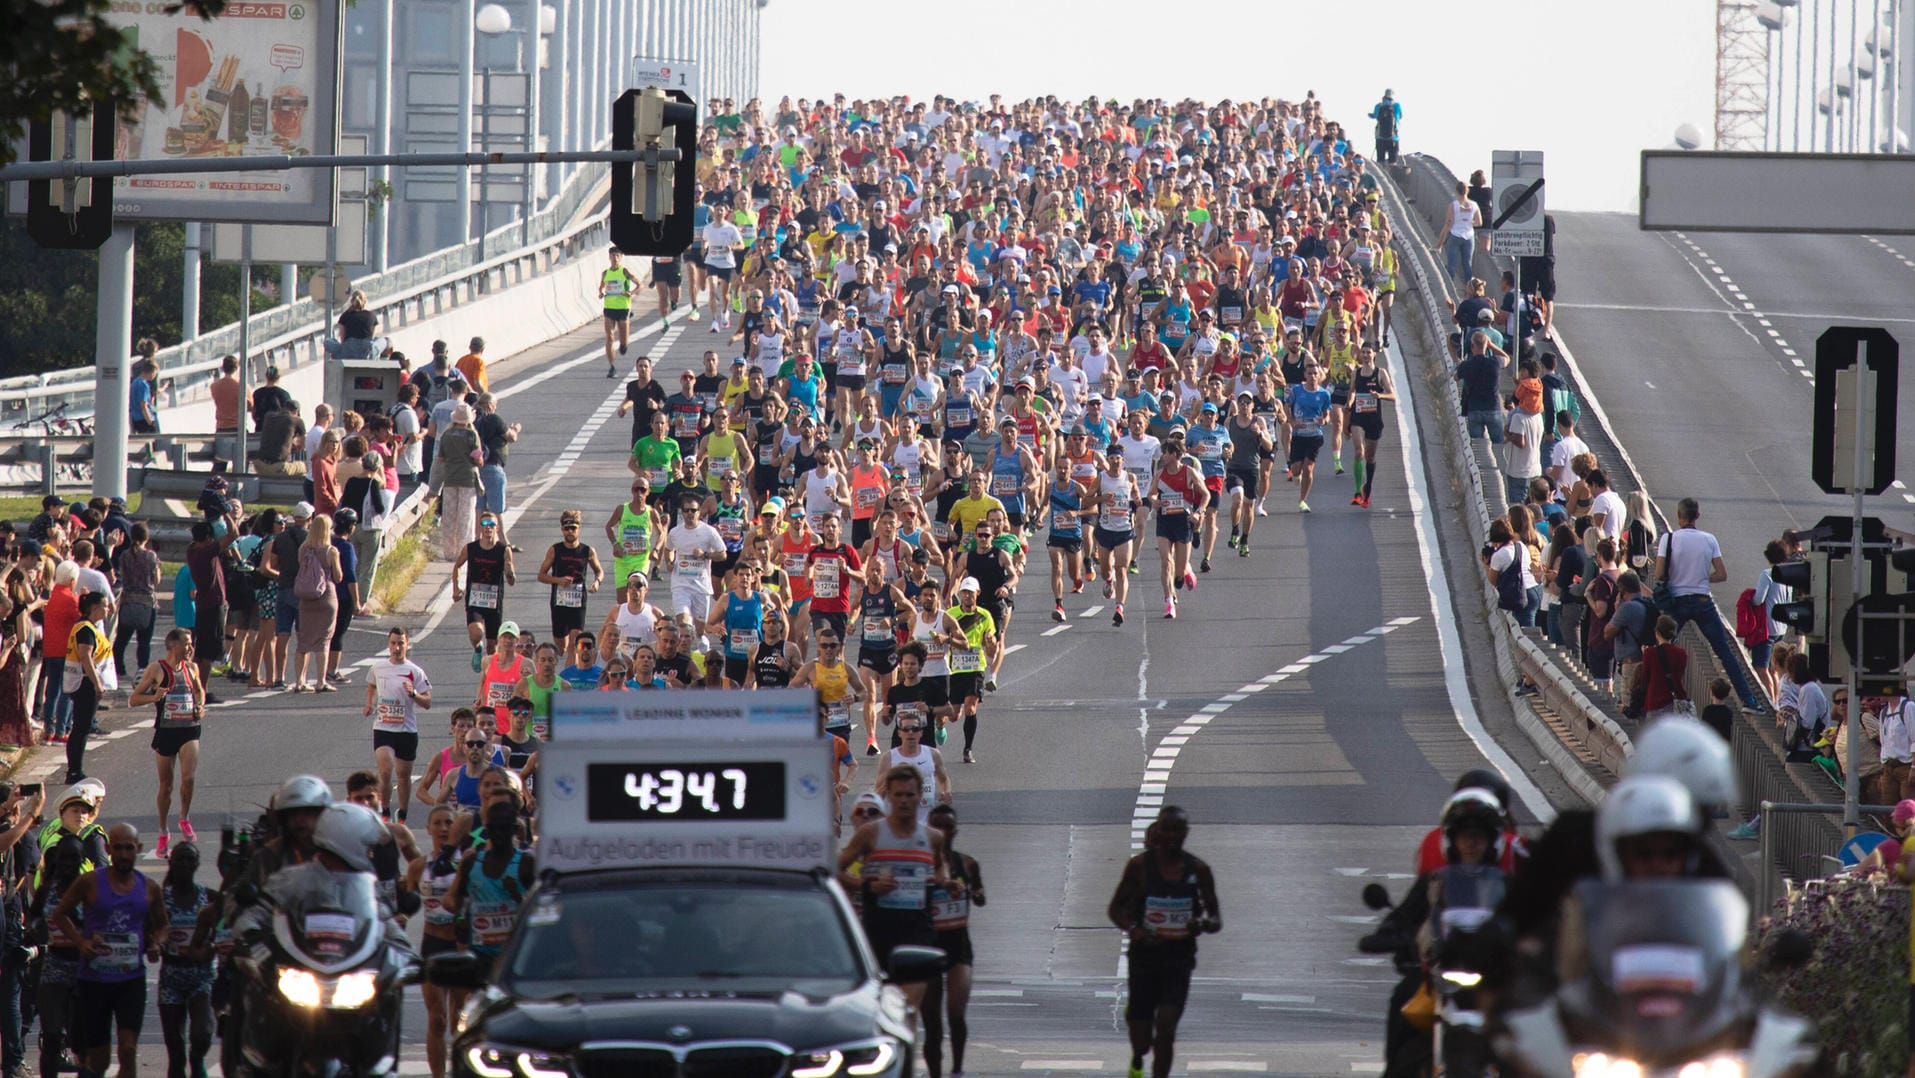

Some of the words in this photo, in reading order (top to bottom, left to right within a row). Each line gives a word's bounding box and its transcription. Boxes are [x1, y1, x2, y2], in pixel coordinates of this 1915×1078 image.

[679, 73, 687, 86] 1
[552, 836, 684, 865] Aufgeladen
[694, 836, 730, 859] mit
[737, 836, 823, 860] Freude
